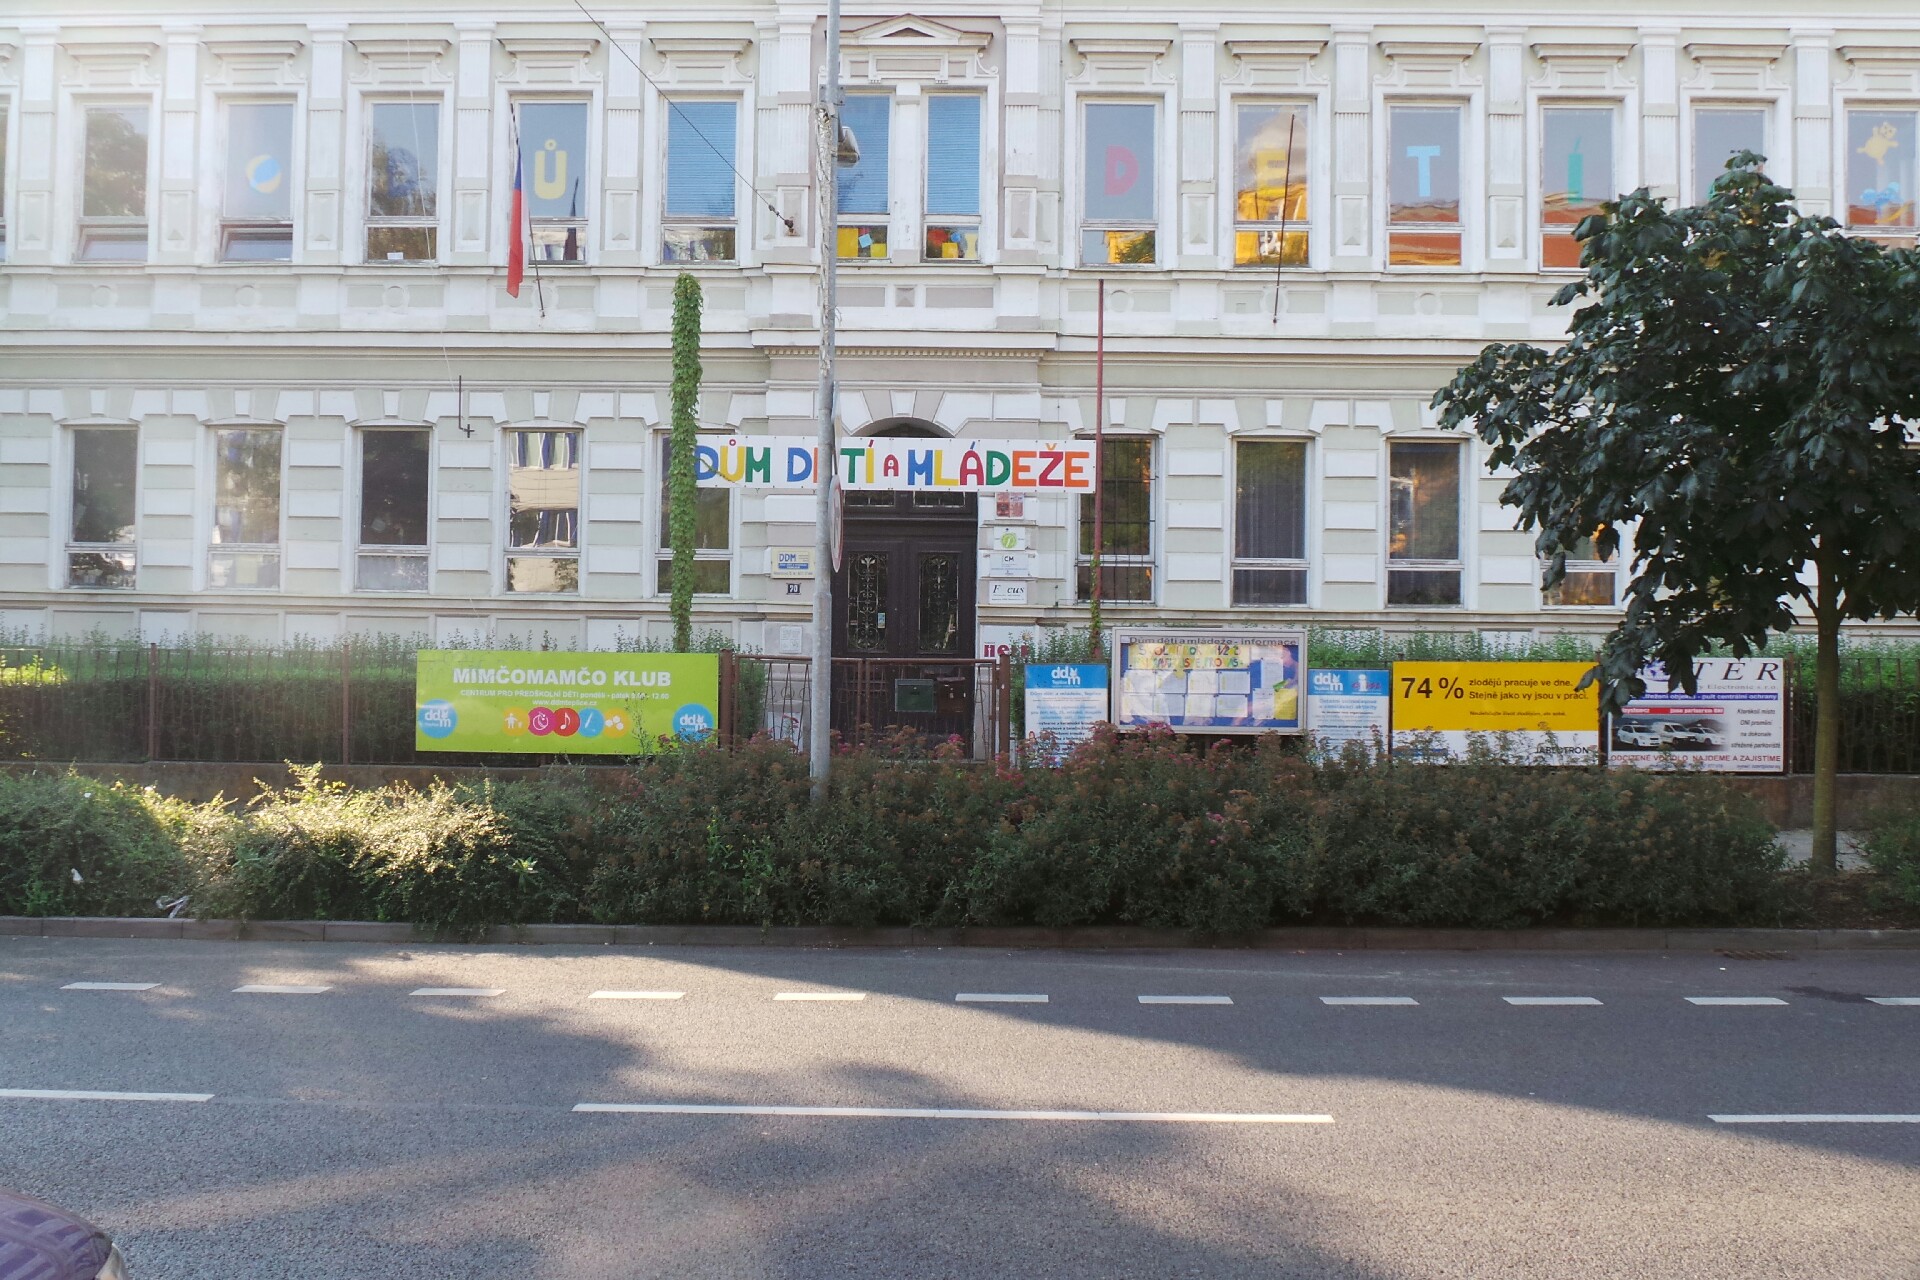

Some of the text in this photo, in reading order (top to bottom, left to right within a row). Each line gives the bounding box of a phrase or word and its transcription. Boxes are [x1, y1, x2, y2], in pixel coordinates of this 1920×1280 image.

[693, 438, 771, 483] DŮM
[786, 439, 875, 484] DTÍ
[907, 441, 1090, 488] MLÁDEŽE
[779, 553, 797, 562] DDM
[453, 665, 672, 687] MIMČOMAMČO KLUB
[460, 689, 496, 697] CENTRUM
[497, 689, 513, 697] PRO
[1401, 677, 1433, 699] 74
[1438, 677, 1464, 699] %
[1504, 679, 1538, 688] pracuje
[1553, 678, 1573, 687] dne.
[1469, 691, 1498, 700] Stejně
[1500, 691, 1520, 700] jako
[1534, 692, 1554, 701] jsou
